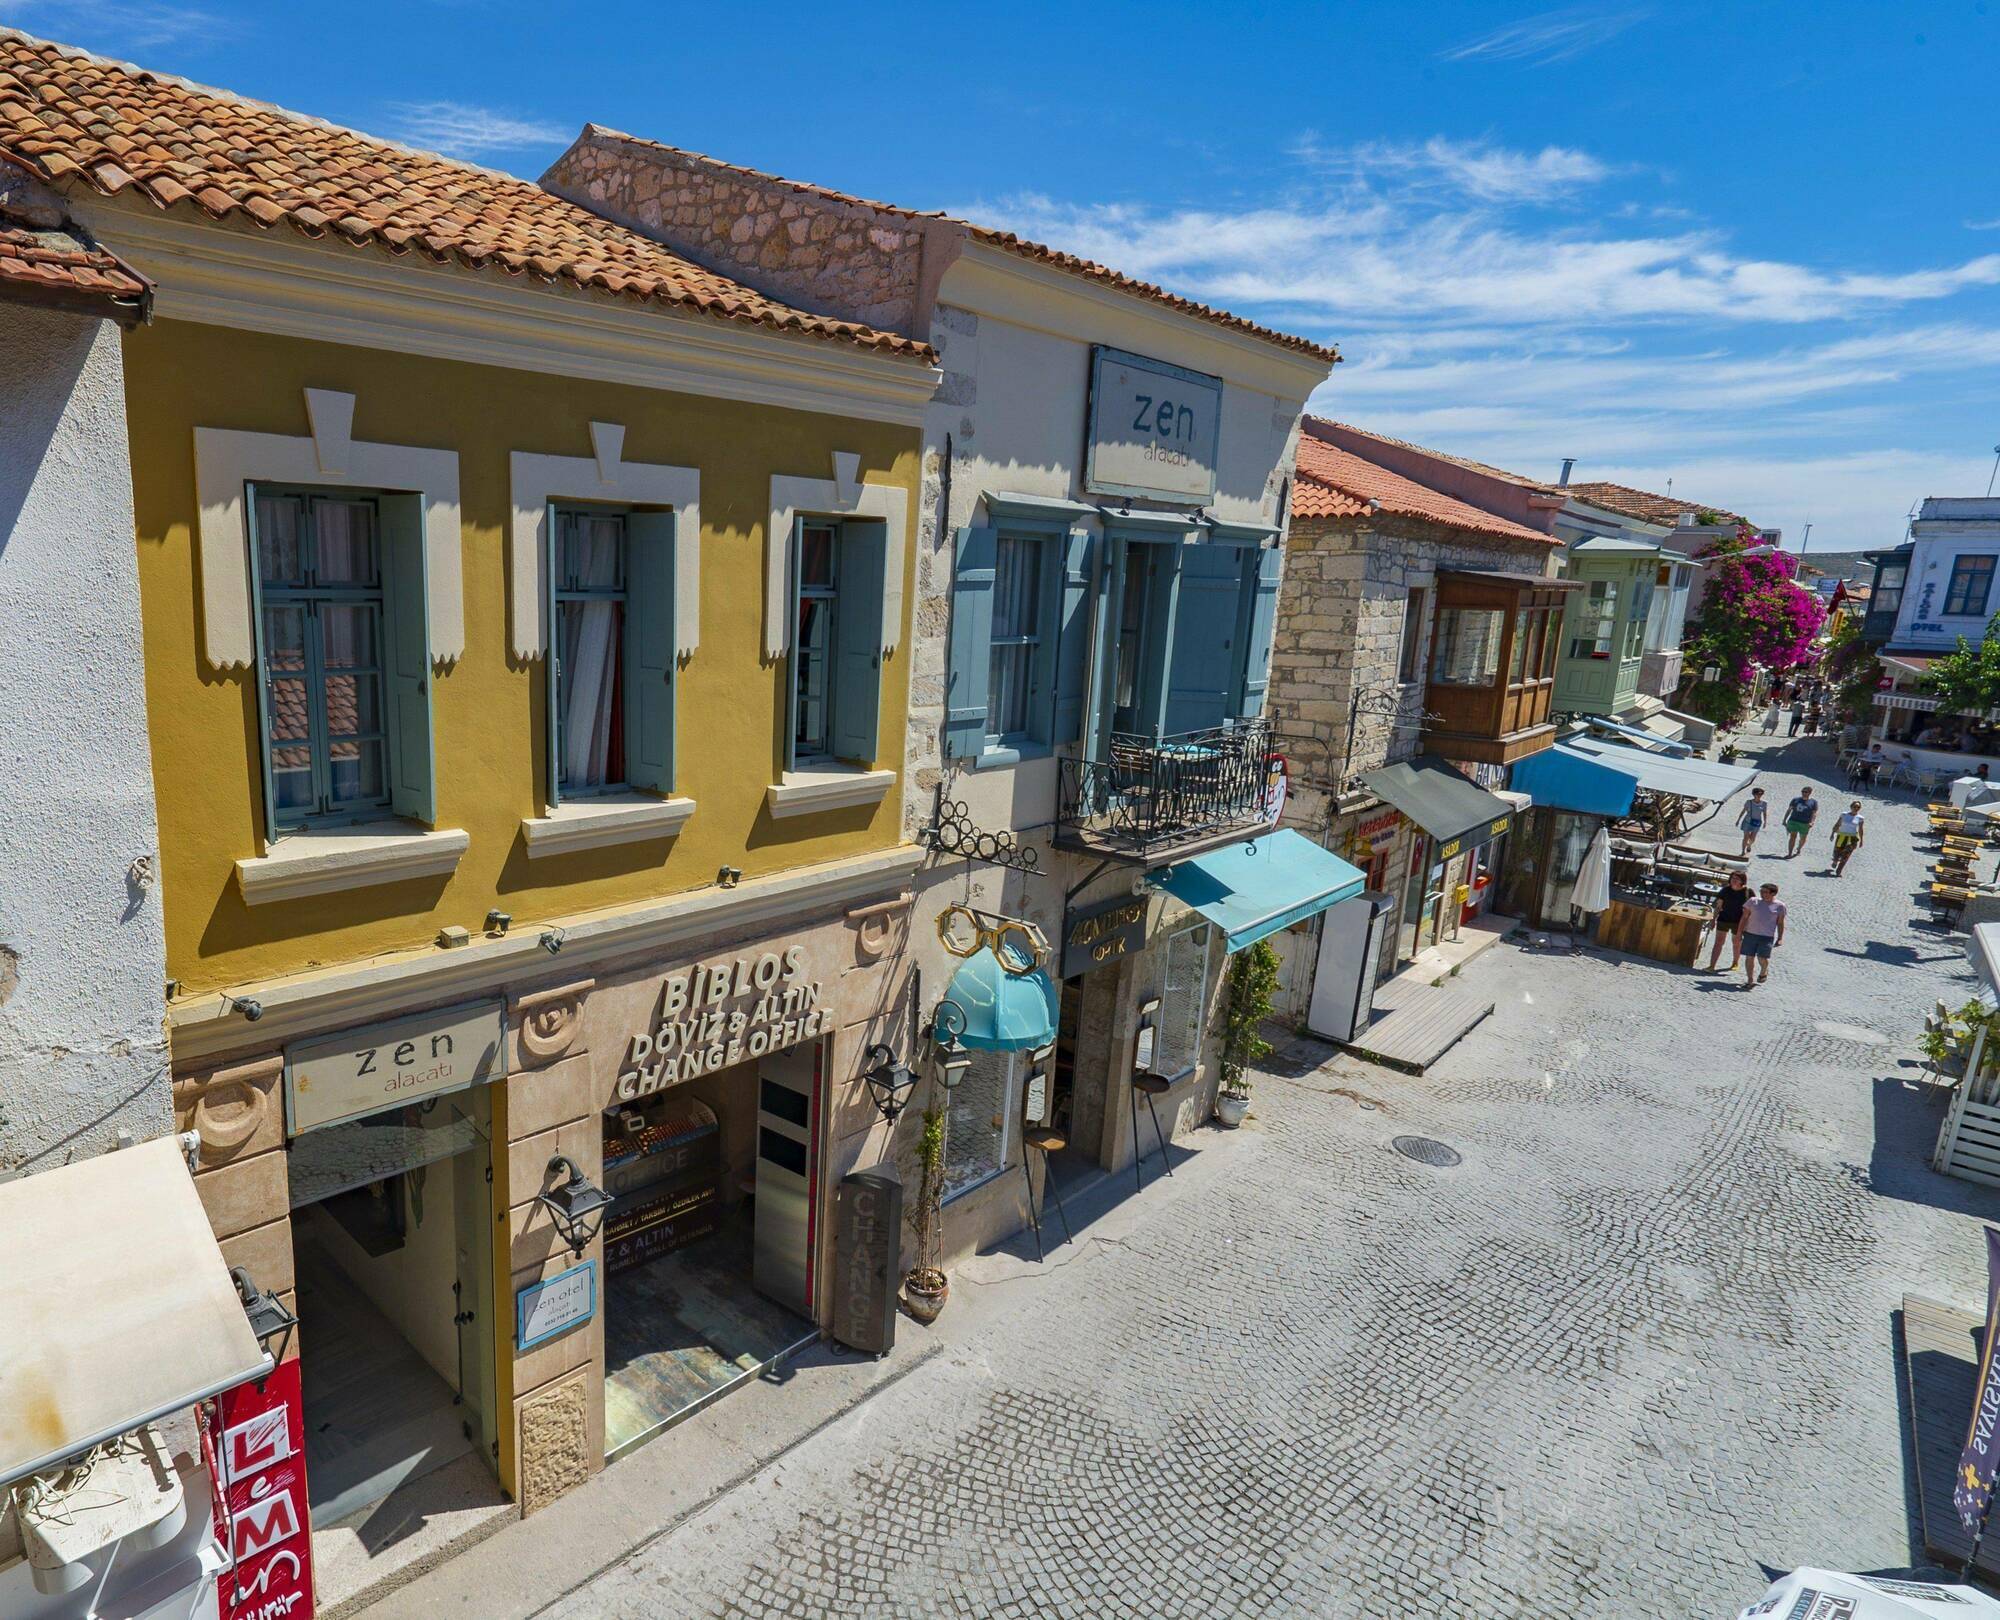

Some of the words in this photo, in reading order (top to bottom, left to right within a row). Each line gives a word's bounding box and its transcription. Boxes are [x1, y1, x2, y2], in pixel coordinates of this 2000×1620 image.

[1132, 394, 1194, 442] zen
[1910, 622, 1945, 632] OTEL
[661, 944, 804, 1019] BİBLOS
[630, 1012, 727, 1064] DÖVİZ
[749, 981, 824, 1028] ALTIN
[355, 1033, 453, 1077] zen
[615, 1038, 744, 1101] CHANGE
[749, 1007, 834, 1058] OFFICE
[635, 1224, 675, 1250] ALTIN
[558, 1277, 584, 1301] otel
[847, 1191, 876, 1343] CHANGE
